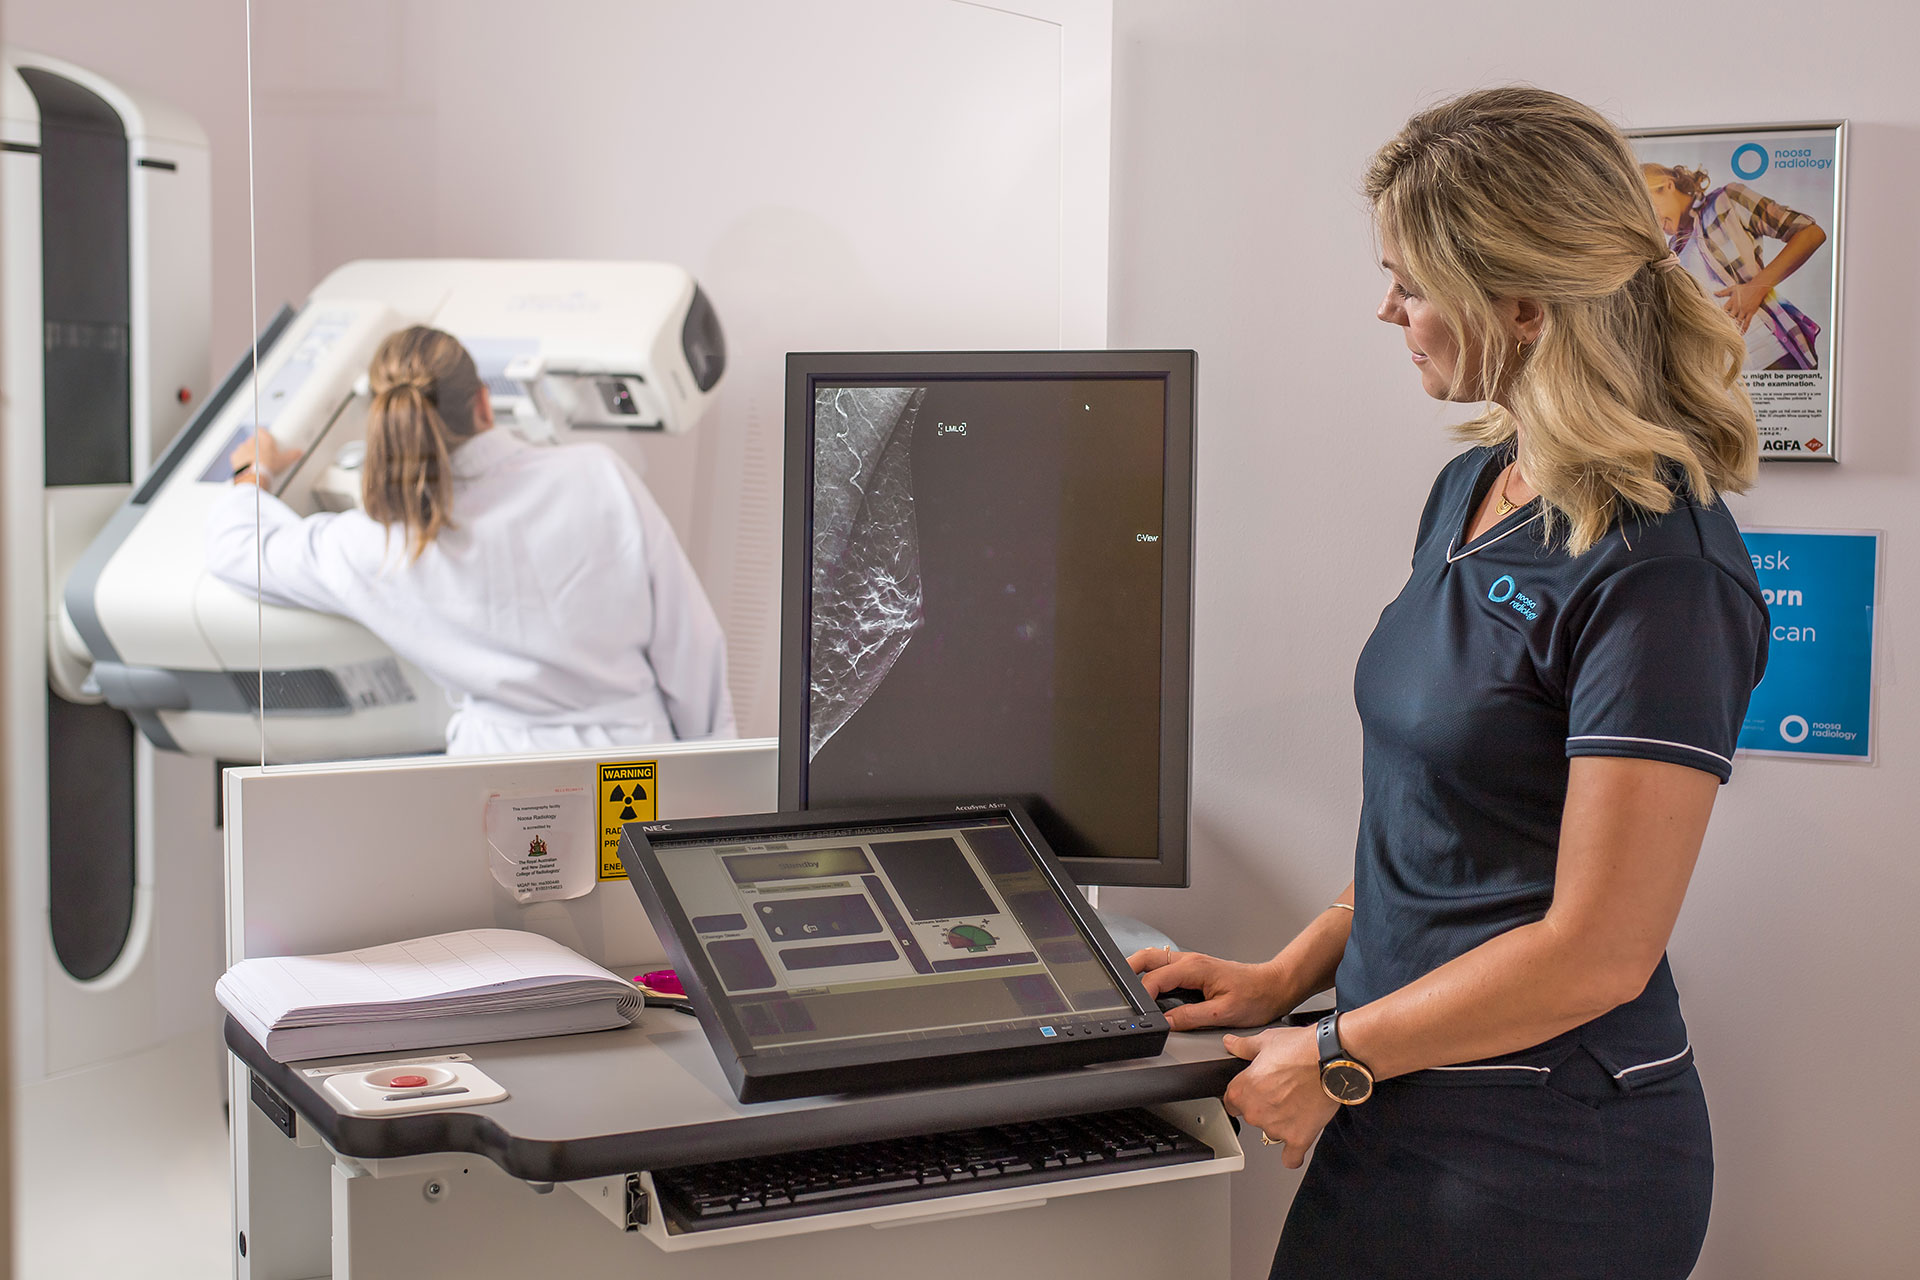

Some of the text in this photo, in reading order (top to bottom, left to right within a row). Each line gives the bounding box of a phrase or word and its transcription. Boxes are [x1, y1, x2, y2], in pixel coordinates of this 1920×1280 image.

[1775, 149, 1811, 158] noosa
[1774, 158, 1832, 169] radiology
[1750, 372, 1772, 380] might
[1786, 372, 1823, 380] pregnant,
[1763, 440, 1801, 451] AGFA
[1136, 533, 1159, 542] C-View
[1750, 550, 1790, 571] ask
[1515, 592, 1537, 609] noosa
[1509, 600, 1538, 620] radiology
[1812, 722, 1841, 731] noosa
[1812, 729, 1857, 740] radiology
[604, 768, 651, 779] WARNING
[642, 824, 673, 832] NEC
